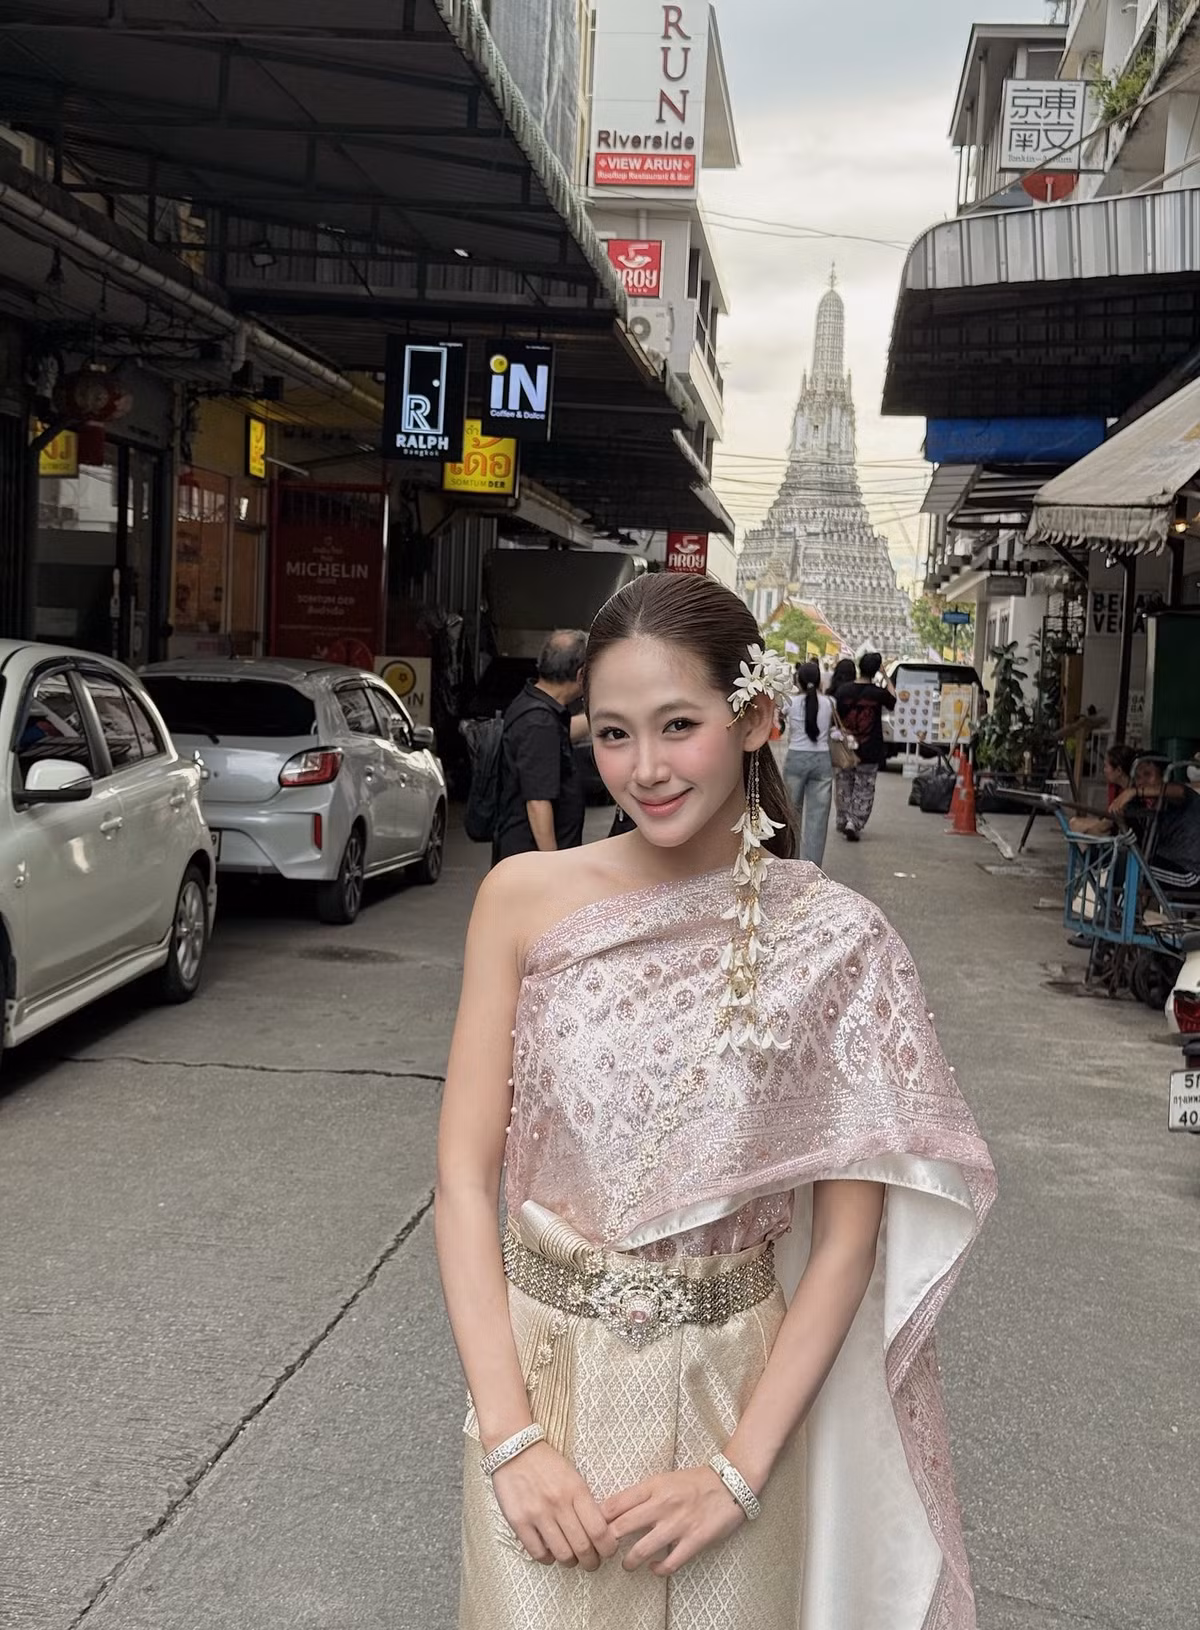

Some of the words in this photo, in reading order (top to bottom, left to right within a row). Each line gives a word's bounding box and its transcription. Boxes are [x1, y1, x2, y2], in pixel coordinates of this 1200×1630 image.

[597, 129, 694, 149] Riverside
[607, 155, 643, 170] VIEW
[643, 157, 683, 171] ARUN
[396, 433, 449, 450] RALPH
[450, 478, 488, 488] SOMTUM
[488, 481, 505, 489] DER
[669, 553, 705, 569] AROY
[286, 560, 369, 580] MICHELIN
